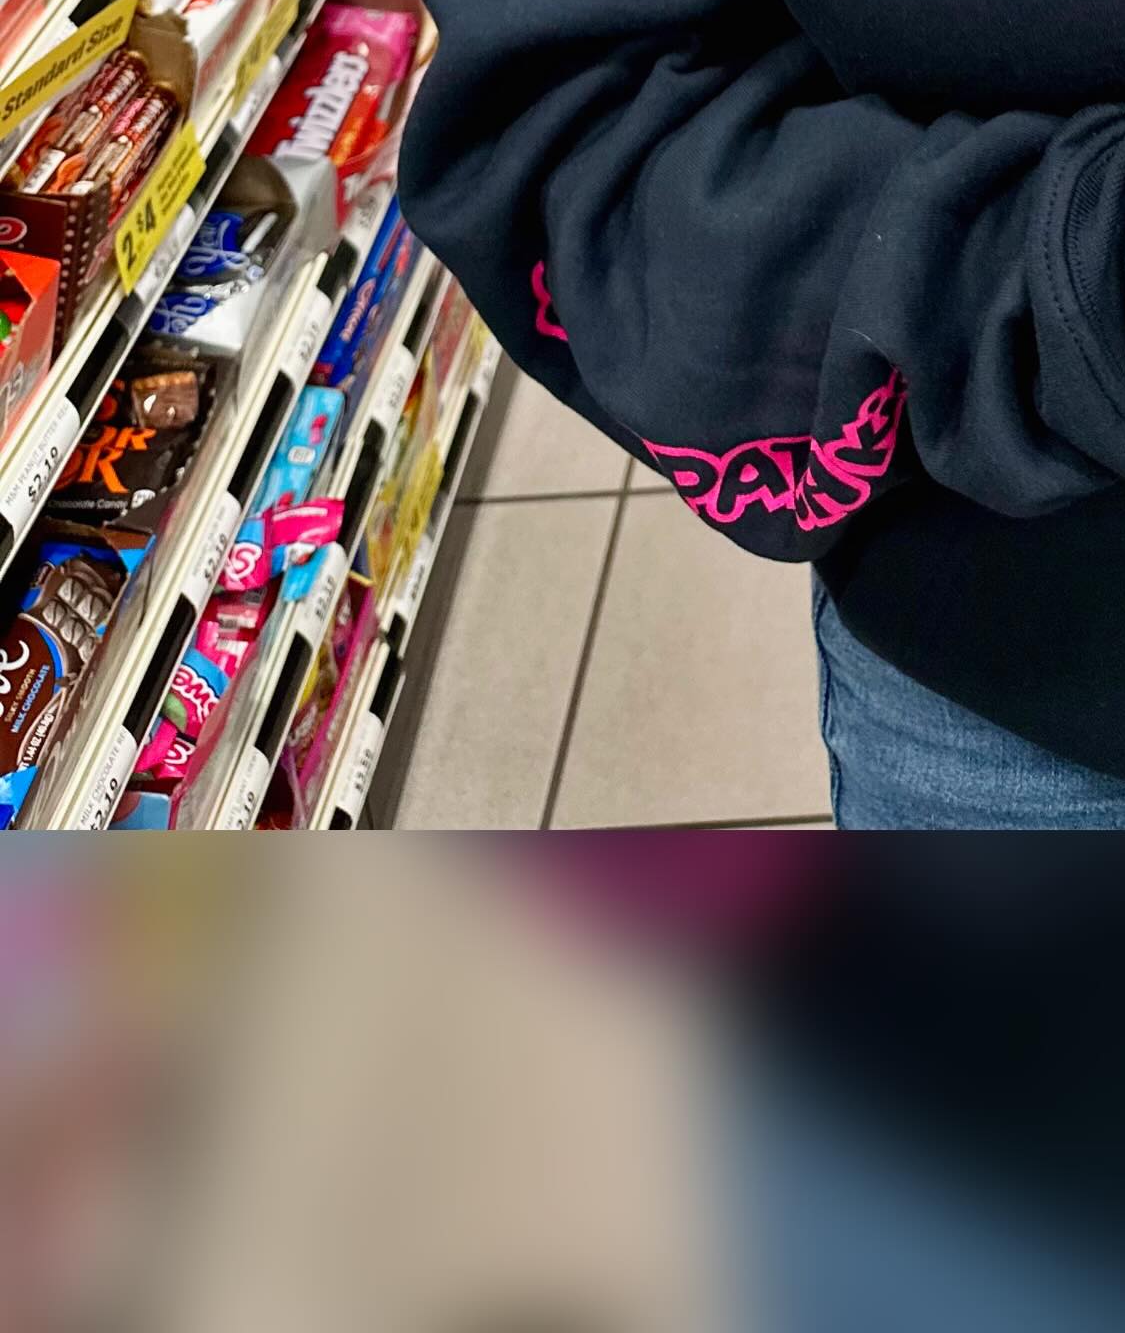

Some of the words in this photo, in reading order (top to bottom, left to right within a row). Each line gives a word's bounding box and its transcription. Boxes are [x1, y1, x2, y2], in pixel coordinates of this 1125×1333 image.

[2, 41, 87, 122] Standard
[86, 16, 124, 54] Size
[10, 710, 26, 734] MILK
[23, 663, 51, 713] CHOCOLATE
